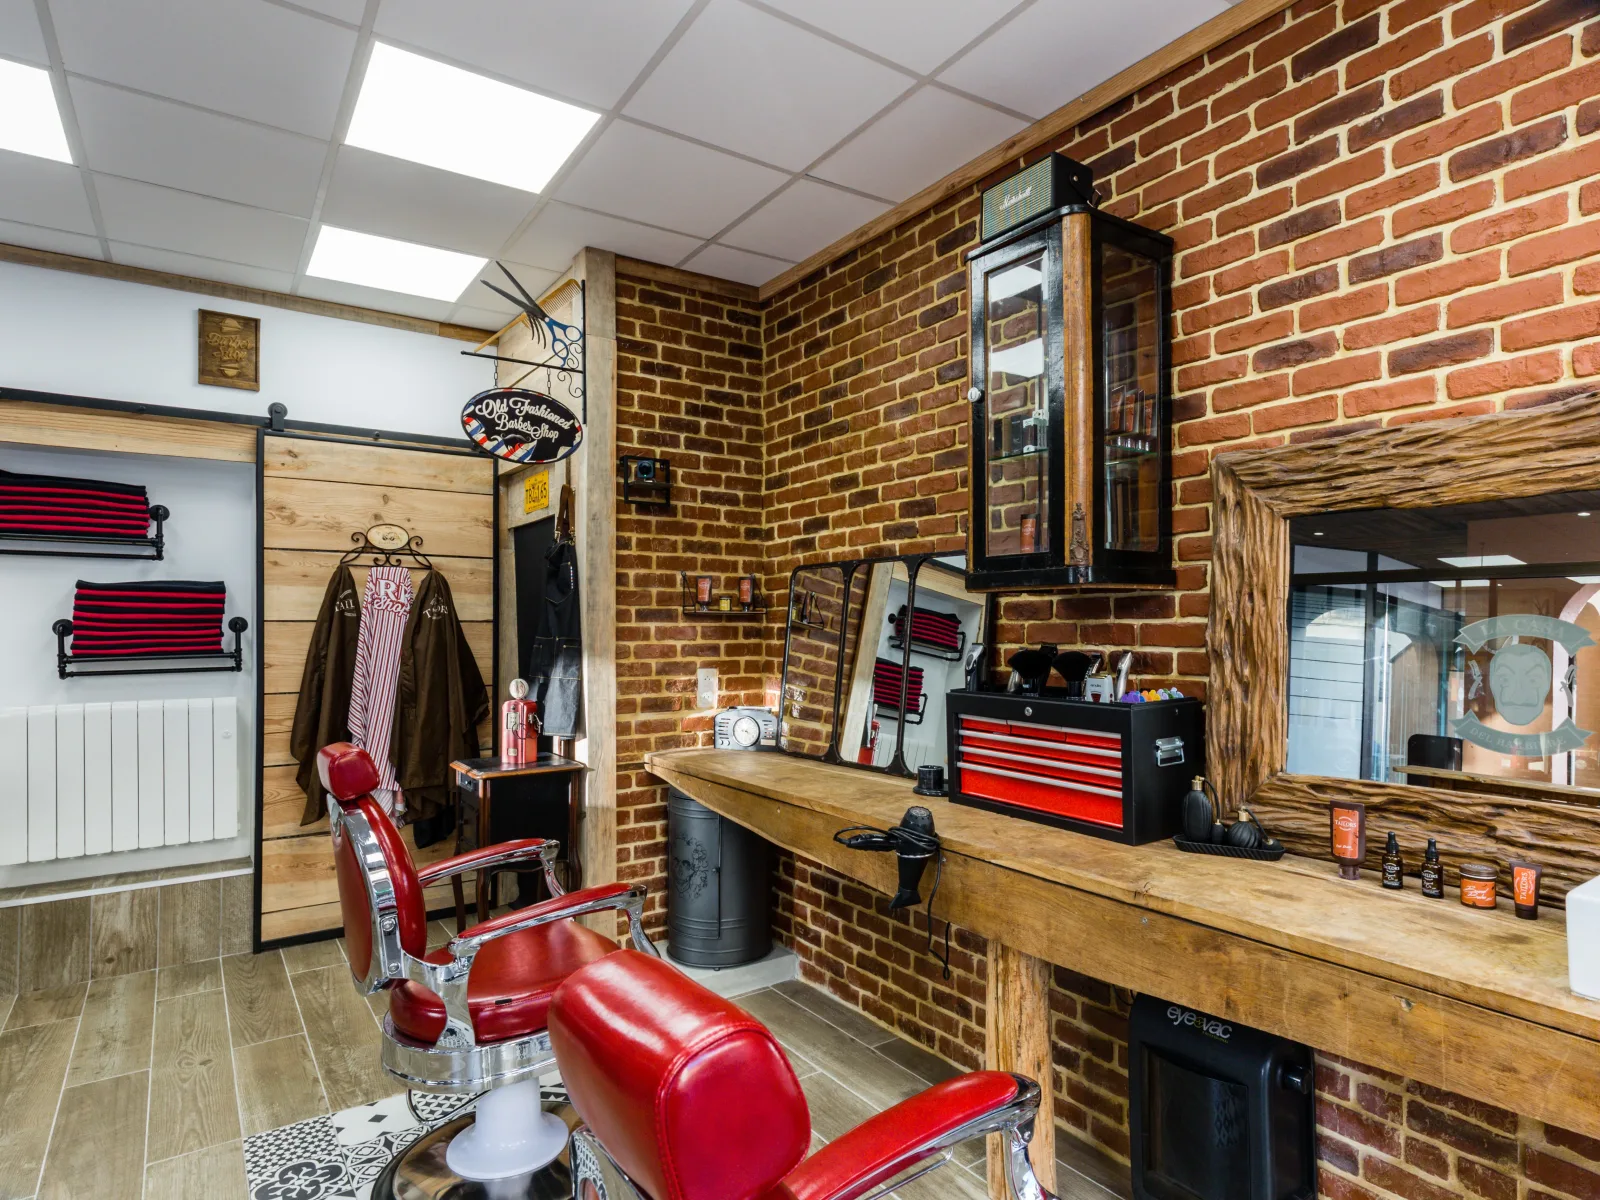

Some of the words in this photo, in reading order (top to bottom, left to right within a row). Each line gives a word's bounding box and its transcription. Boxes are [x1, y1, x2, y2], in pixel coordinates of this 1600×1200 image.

[475, 399, 509, 418] Old
[509, 397, 573, 429] Fashioned
[495, 412, 532, 433] Barber
[531, 423, 559, 443] Shop
[1480, 618, 1508, 637] LA
[1469, 727, 1493, 743] DEL
